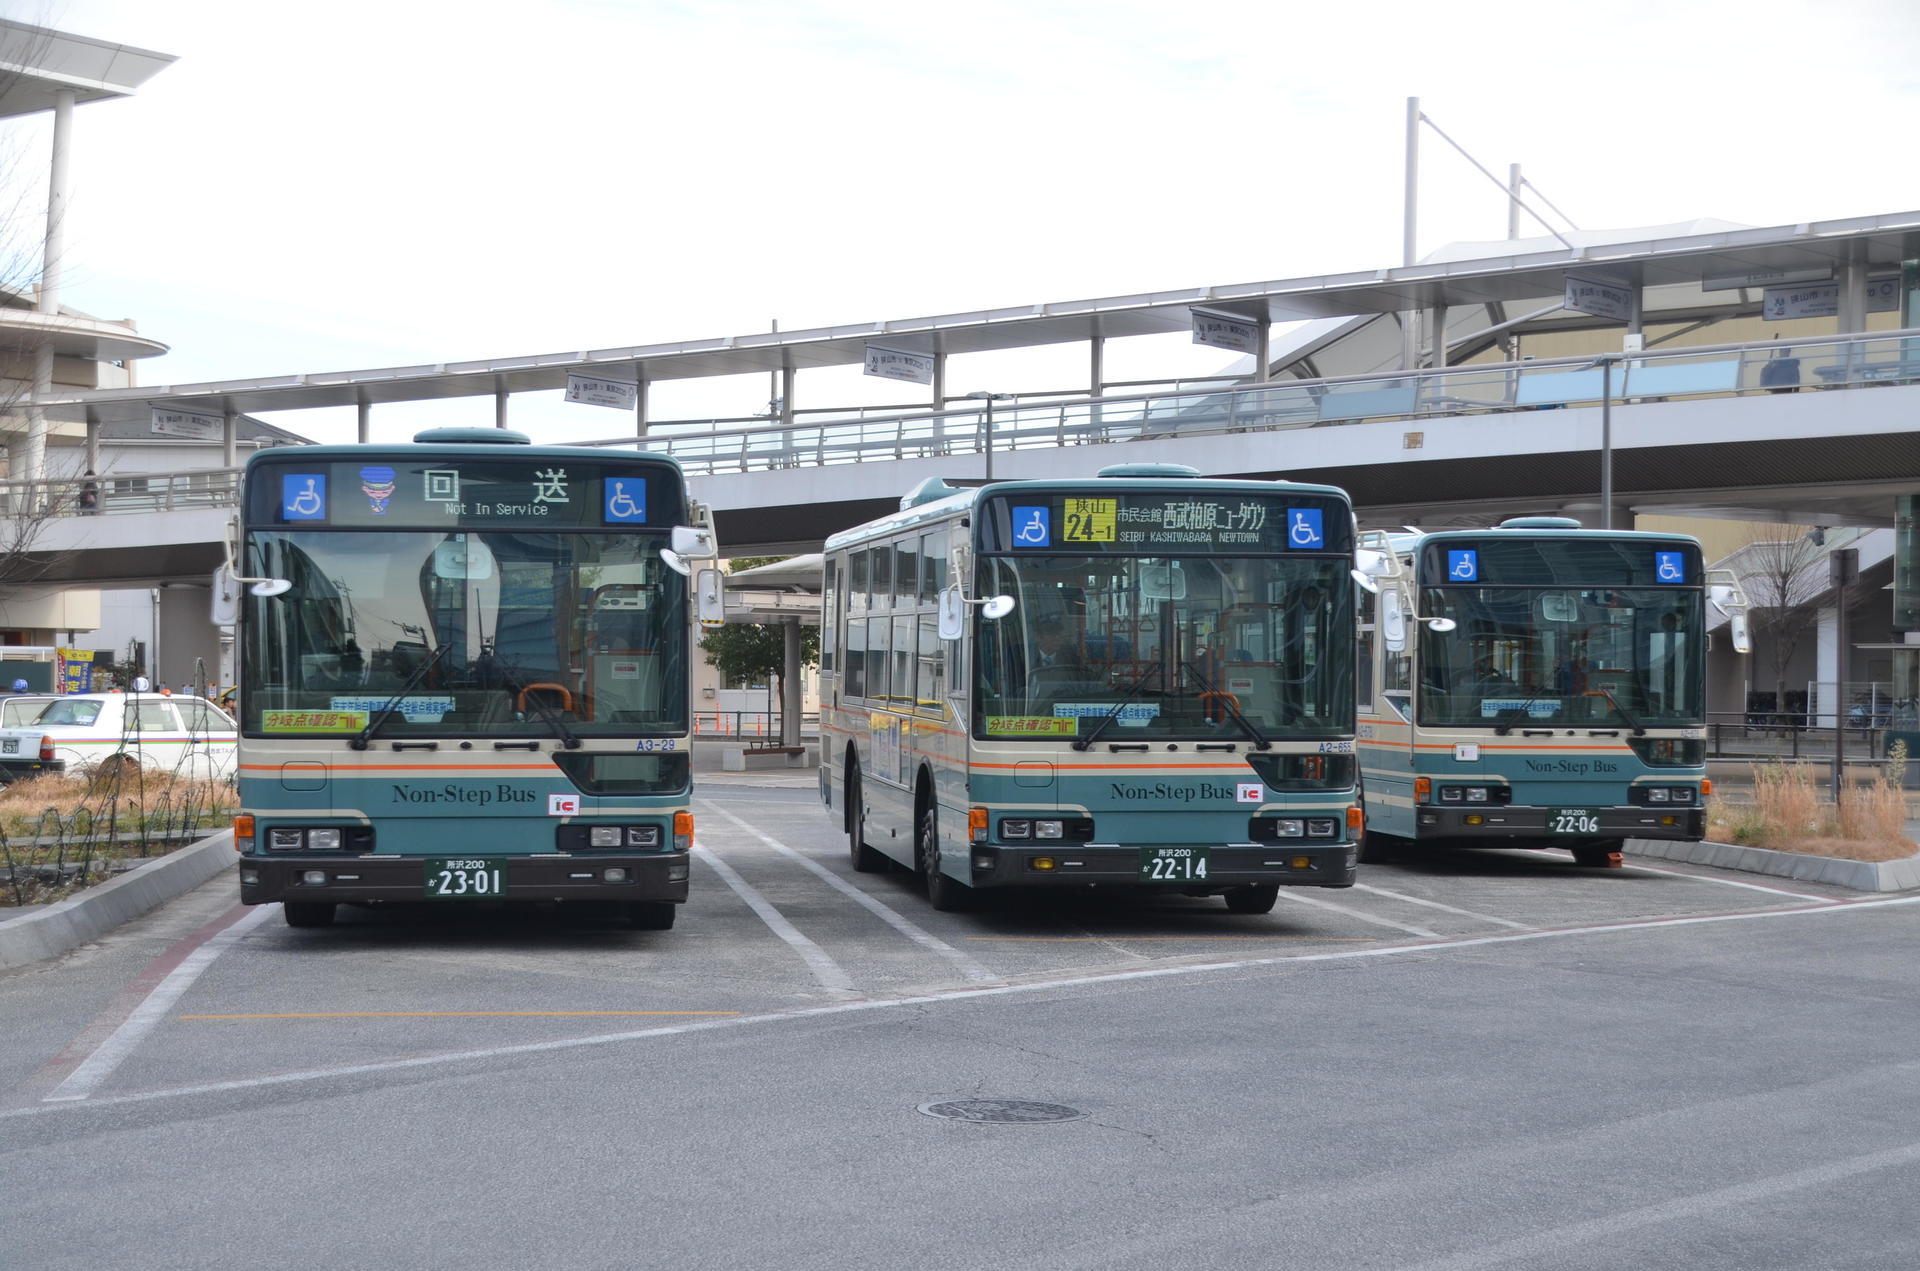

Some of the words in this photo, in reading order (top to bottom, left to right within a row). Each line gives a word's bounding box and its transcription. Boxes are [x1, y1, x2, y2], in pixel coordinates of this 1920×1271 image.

[445, 502, 466, 516] Not
[475, 502, 490, 516] In
[496, 502, 548, 516] Service
[1075, 499, 1106, 514] 狭山
[1117, 507, 1162, 523] 市民会館
[1067, 513, 1112, 540] 24-1
[1119, 531, 1144, 543] SEIBU
[1150, 531, 1212, 543] KASHIWABARA
[1218, 532, 1260, 544] NEWTOWN
[266, 714, 337, 727] 分岐点確認
[989, 719, 1051, 731] 分岐点確認
[636, 740, 676, 751] A3-29
[1526, 760, 1588, 776] Non-Step
[1593, 761, 1617, 773] Bus
[392, 785, 491, 806] Non-Step
[496, 785, 536, 803] Bus
[1110, 784, 1196, 802] Non-Step
[1200, 784, 1234, 800] Bus
[1555, 816, 1598, 833] 22-06
[1158, 848, 1191, 857] 所沢200
[446, 860, 485, 870] 所沢200
[1151, 858, 1206, 879] 22-14
[437, 870, 500, 894] 23-01
